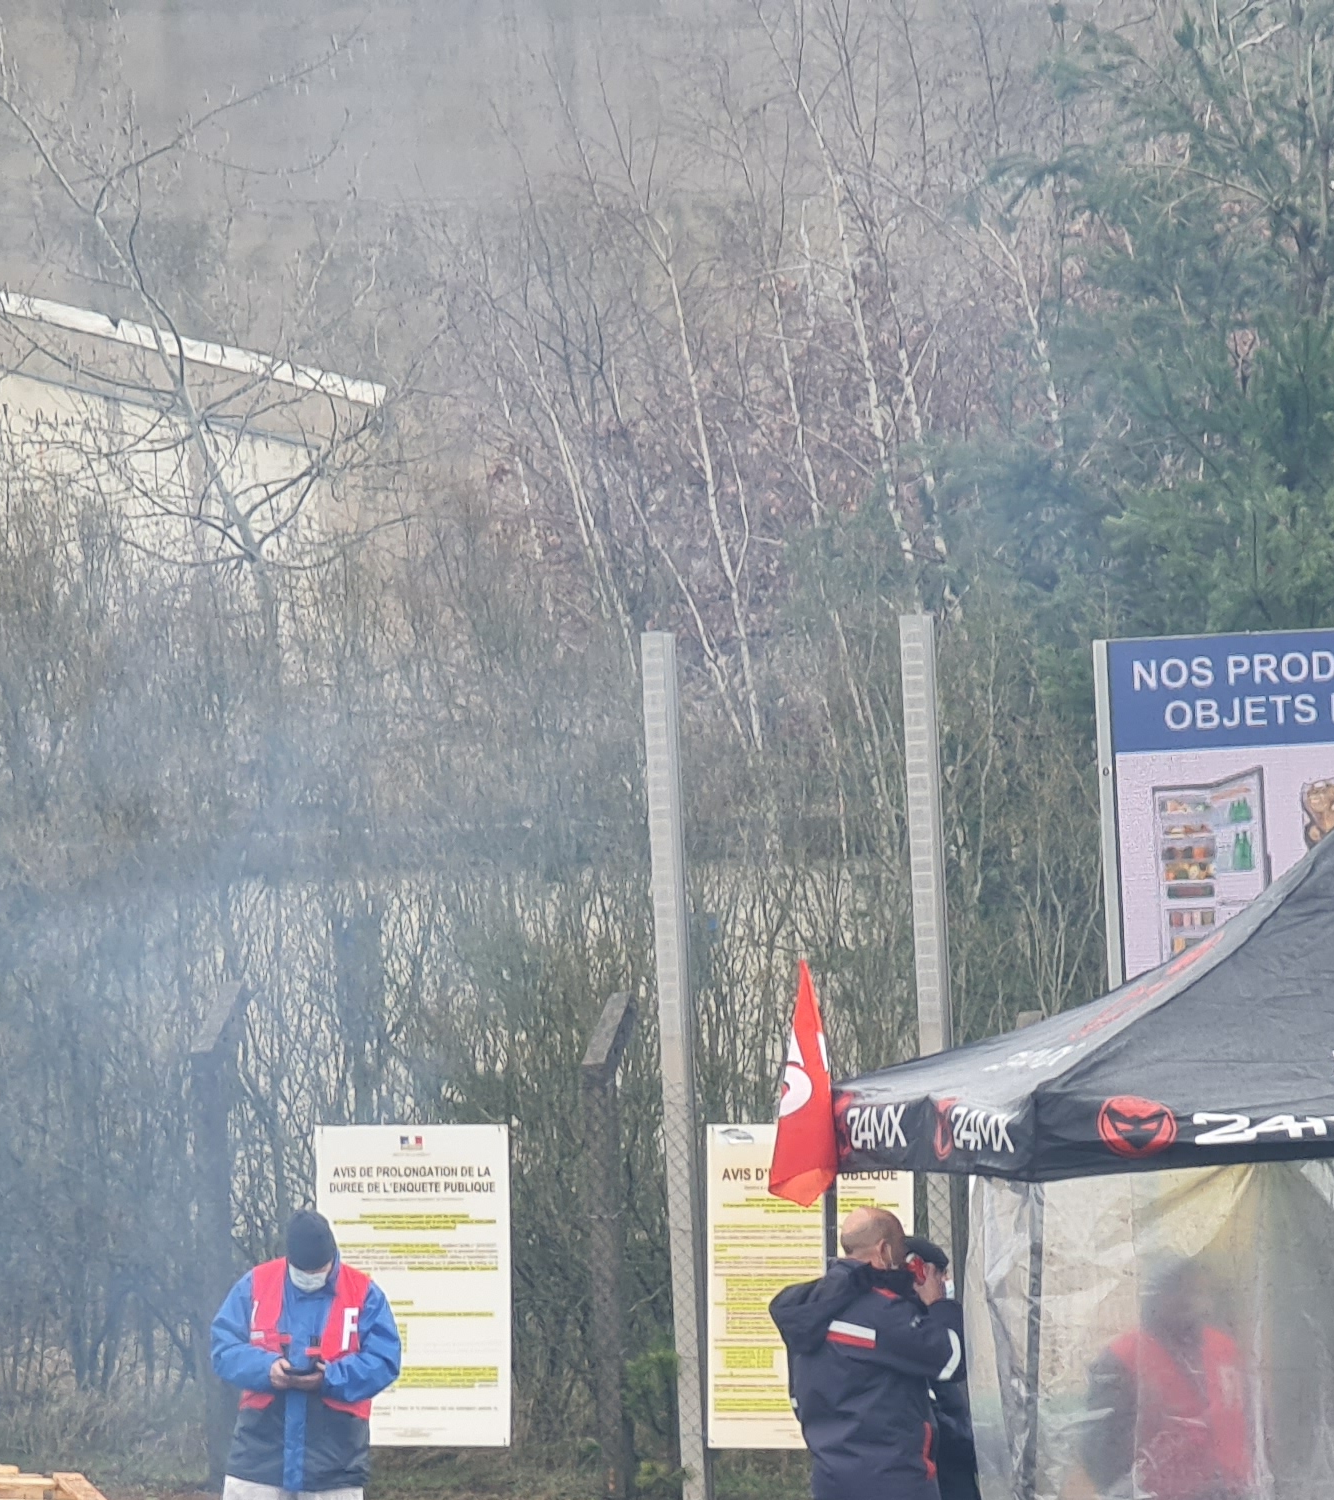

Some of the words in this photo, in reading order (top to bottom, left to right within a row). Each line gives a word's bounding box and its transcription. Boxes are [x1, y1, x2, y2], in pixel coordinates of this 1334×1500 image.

[1132, 656, 1215, 691] NOS
[1164, 693, 1318, 731] OBJETS
[846, 1103, 908, 1151] 24MX
[951, 1105, 1019, 1153] 24MX
[333, 1166, 357, 1178] AVIS
[359, 1166, 373, 1178] DE
[376, 1166, 458, 1178] PROLONGATION
[460, 1166, 475, 1178] DE
[477, 1166, 491, 1178] LA
[367, 1182, 380, 1194] DE
[444, 1181, 496, 1194] PUBLIQUE
[722, 1167, 751, 1181] AVIS
